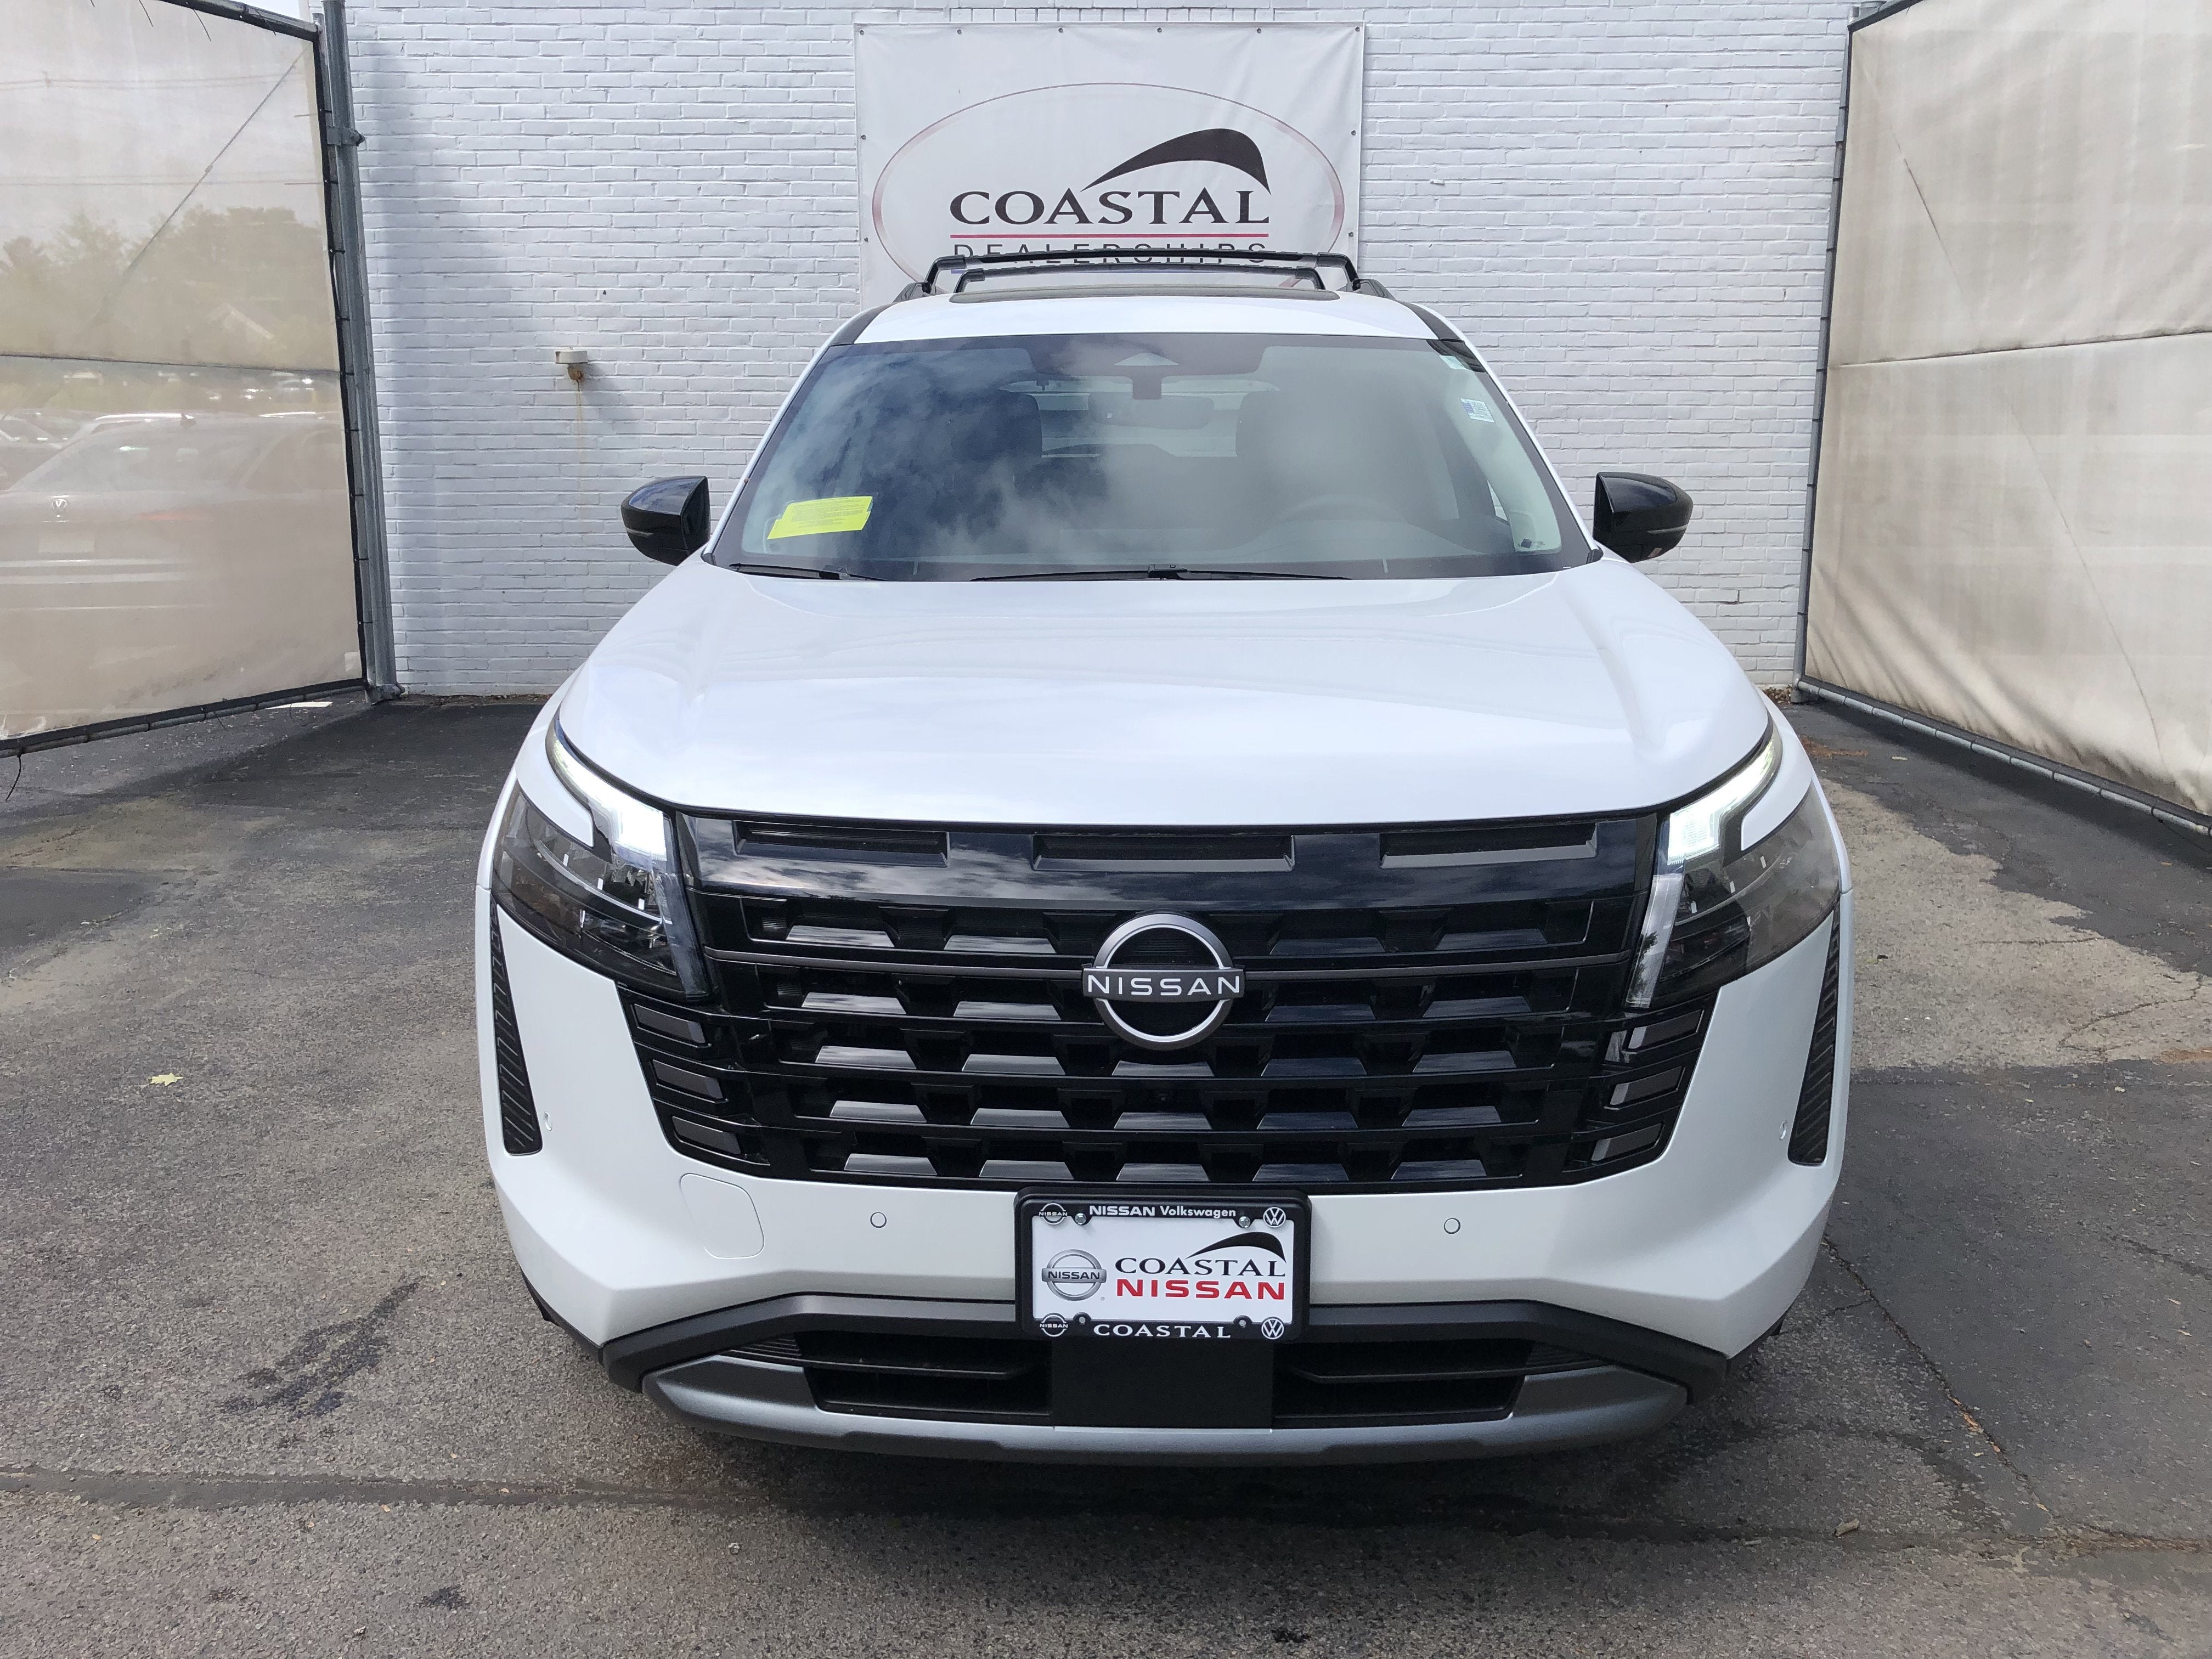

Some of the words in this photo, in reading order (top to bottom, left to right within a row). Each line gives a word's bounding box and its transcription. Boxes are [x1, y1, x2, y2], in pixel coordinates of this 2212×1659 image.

[950, 187, 1269, 225] COASTAL
[1087, 974, 1240, 996] NISSAN
[1089, 1205, 1155, 1216] NISSAN
[1160, 1205, 1236, 1219] Volkswagen
[1048, 1271, 1100, 1279] NISSAN
[1115, 1257, 1286, 1277] COASTAL
[1116, 1278, 1285, 1300] NISSAN
[1093, 1324, 1231, 1338] COASTAL
